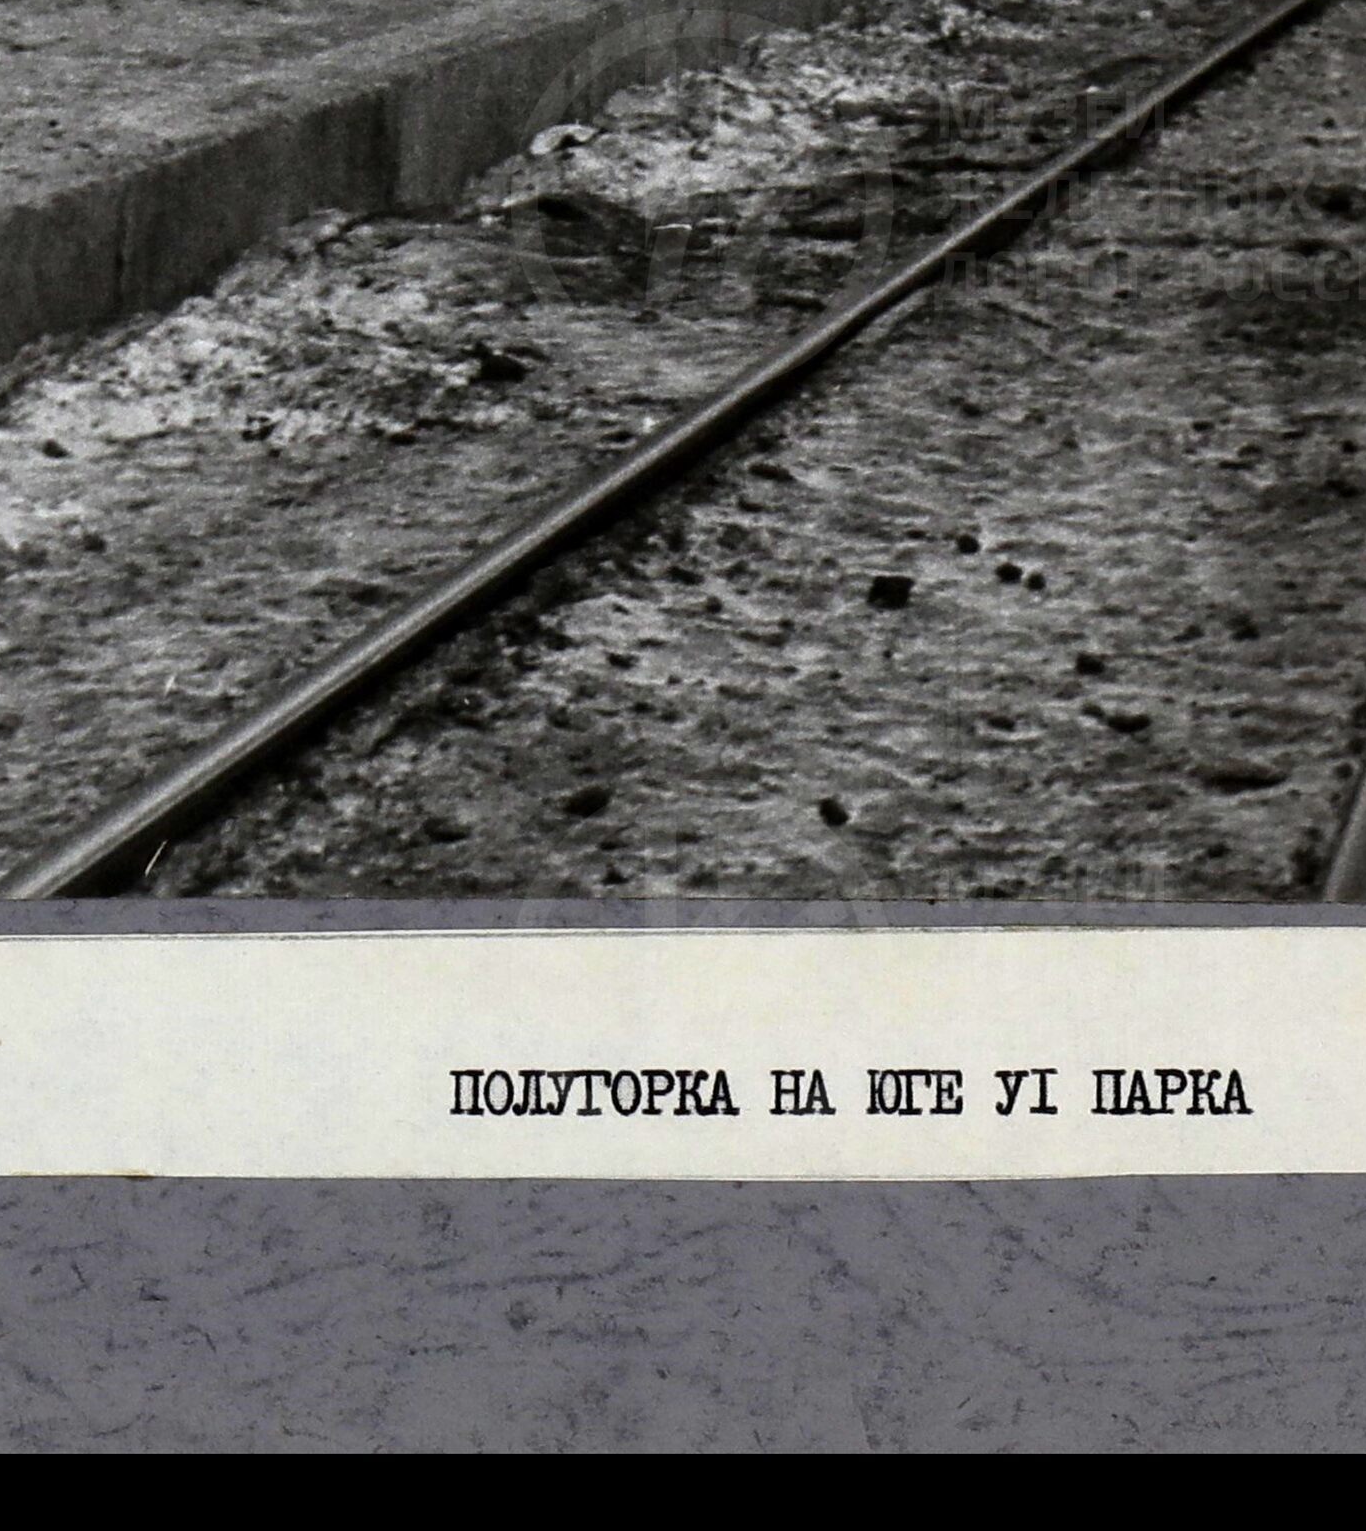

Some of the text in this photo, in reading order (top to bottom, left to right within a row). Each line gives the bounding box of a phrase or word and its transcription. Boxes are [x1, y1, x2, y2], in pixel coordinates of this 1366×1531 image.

[449, 1068, 740, 1116] ПОЛУГОРКА
[769, 1068, 836, 1116] НА
[866, 1068, 963, 1116] ЮГЕ
[1090, 1068, 1253, 1116] ПАРКА
